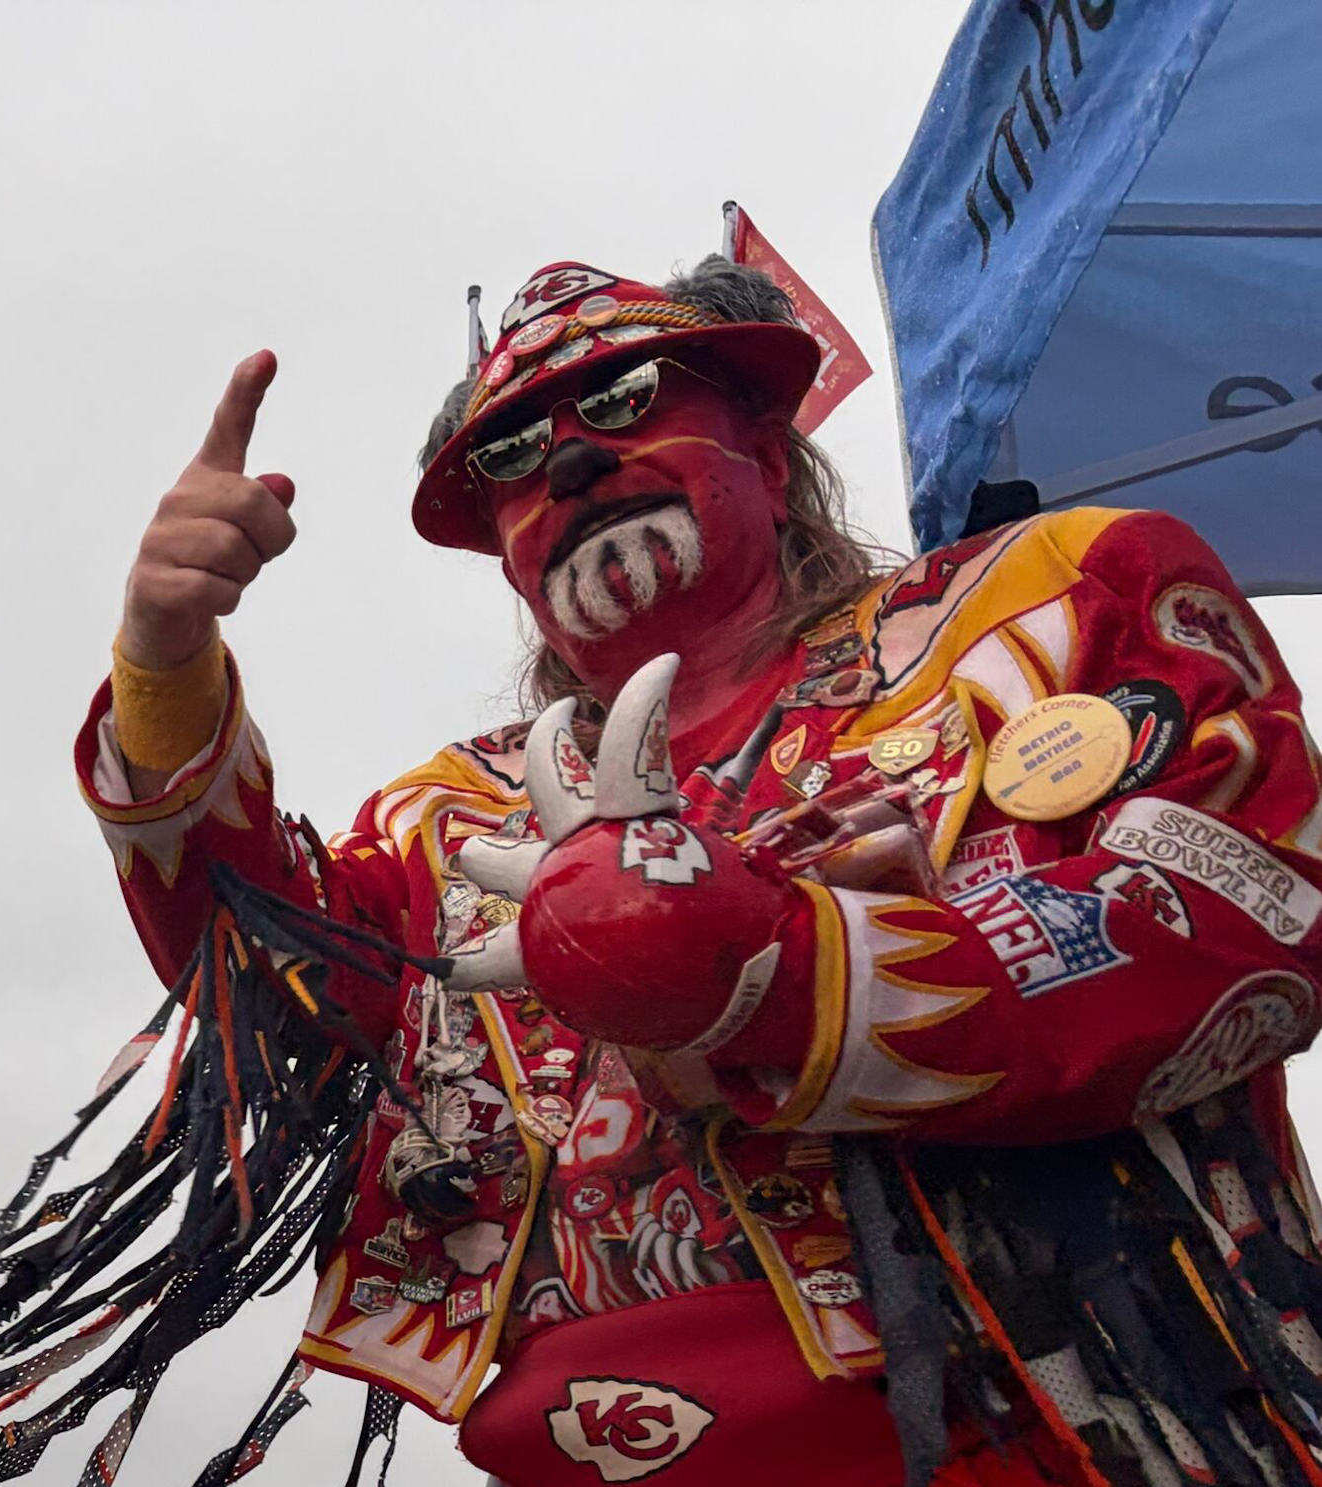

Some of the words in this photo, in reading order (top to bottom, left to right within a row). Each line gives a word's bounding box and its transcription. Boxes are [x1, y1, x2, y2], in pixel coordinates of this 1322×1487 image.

[1041, 698, 1093, 713] Corner
[880, 739, 923, 758] 50
[1136, 720, 1174, 778] Association
[1107, 826, 1246, 904] BOWL
[1152, 808, 1295, 905] SUPER
[575, 1391, 680, 1461] KC
